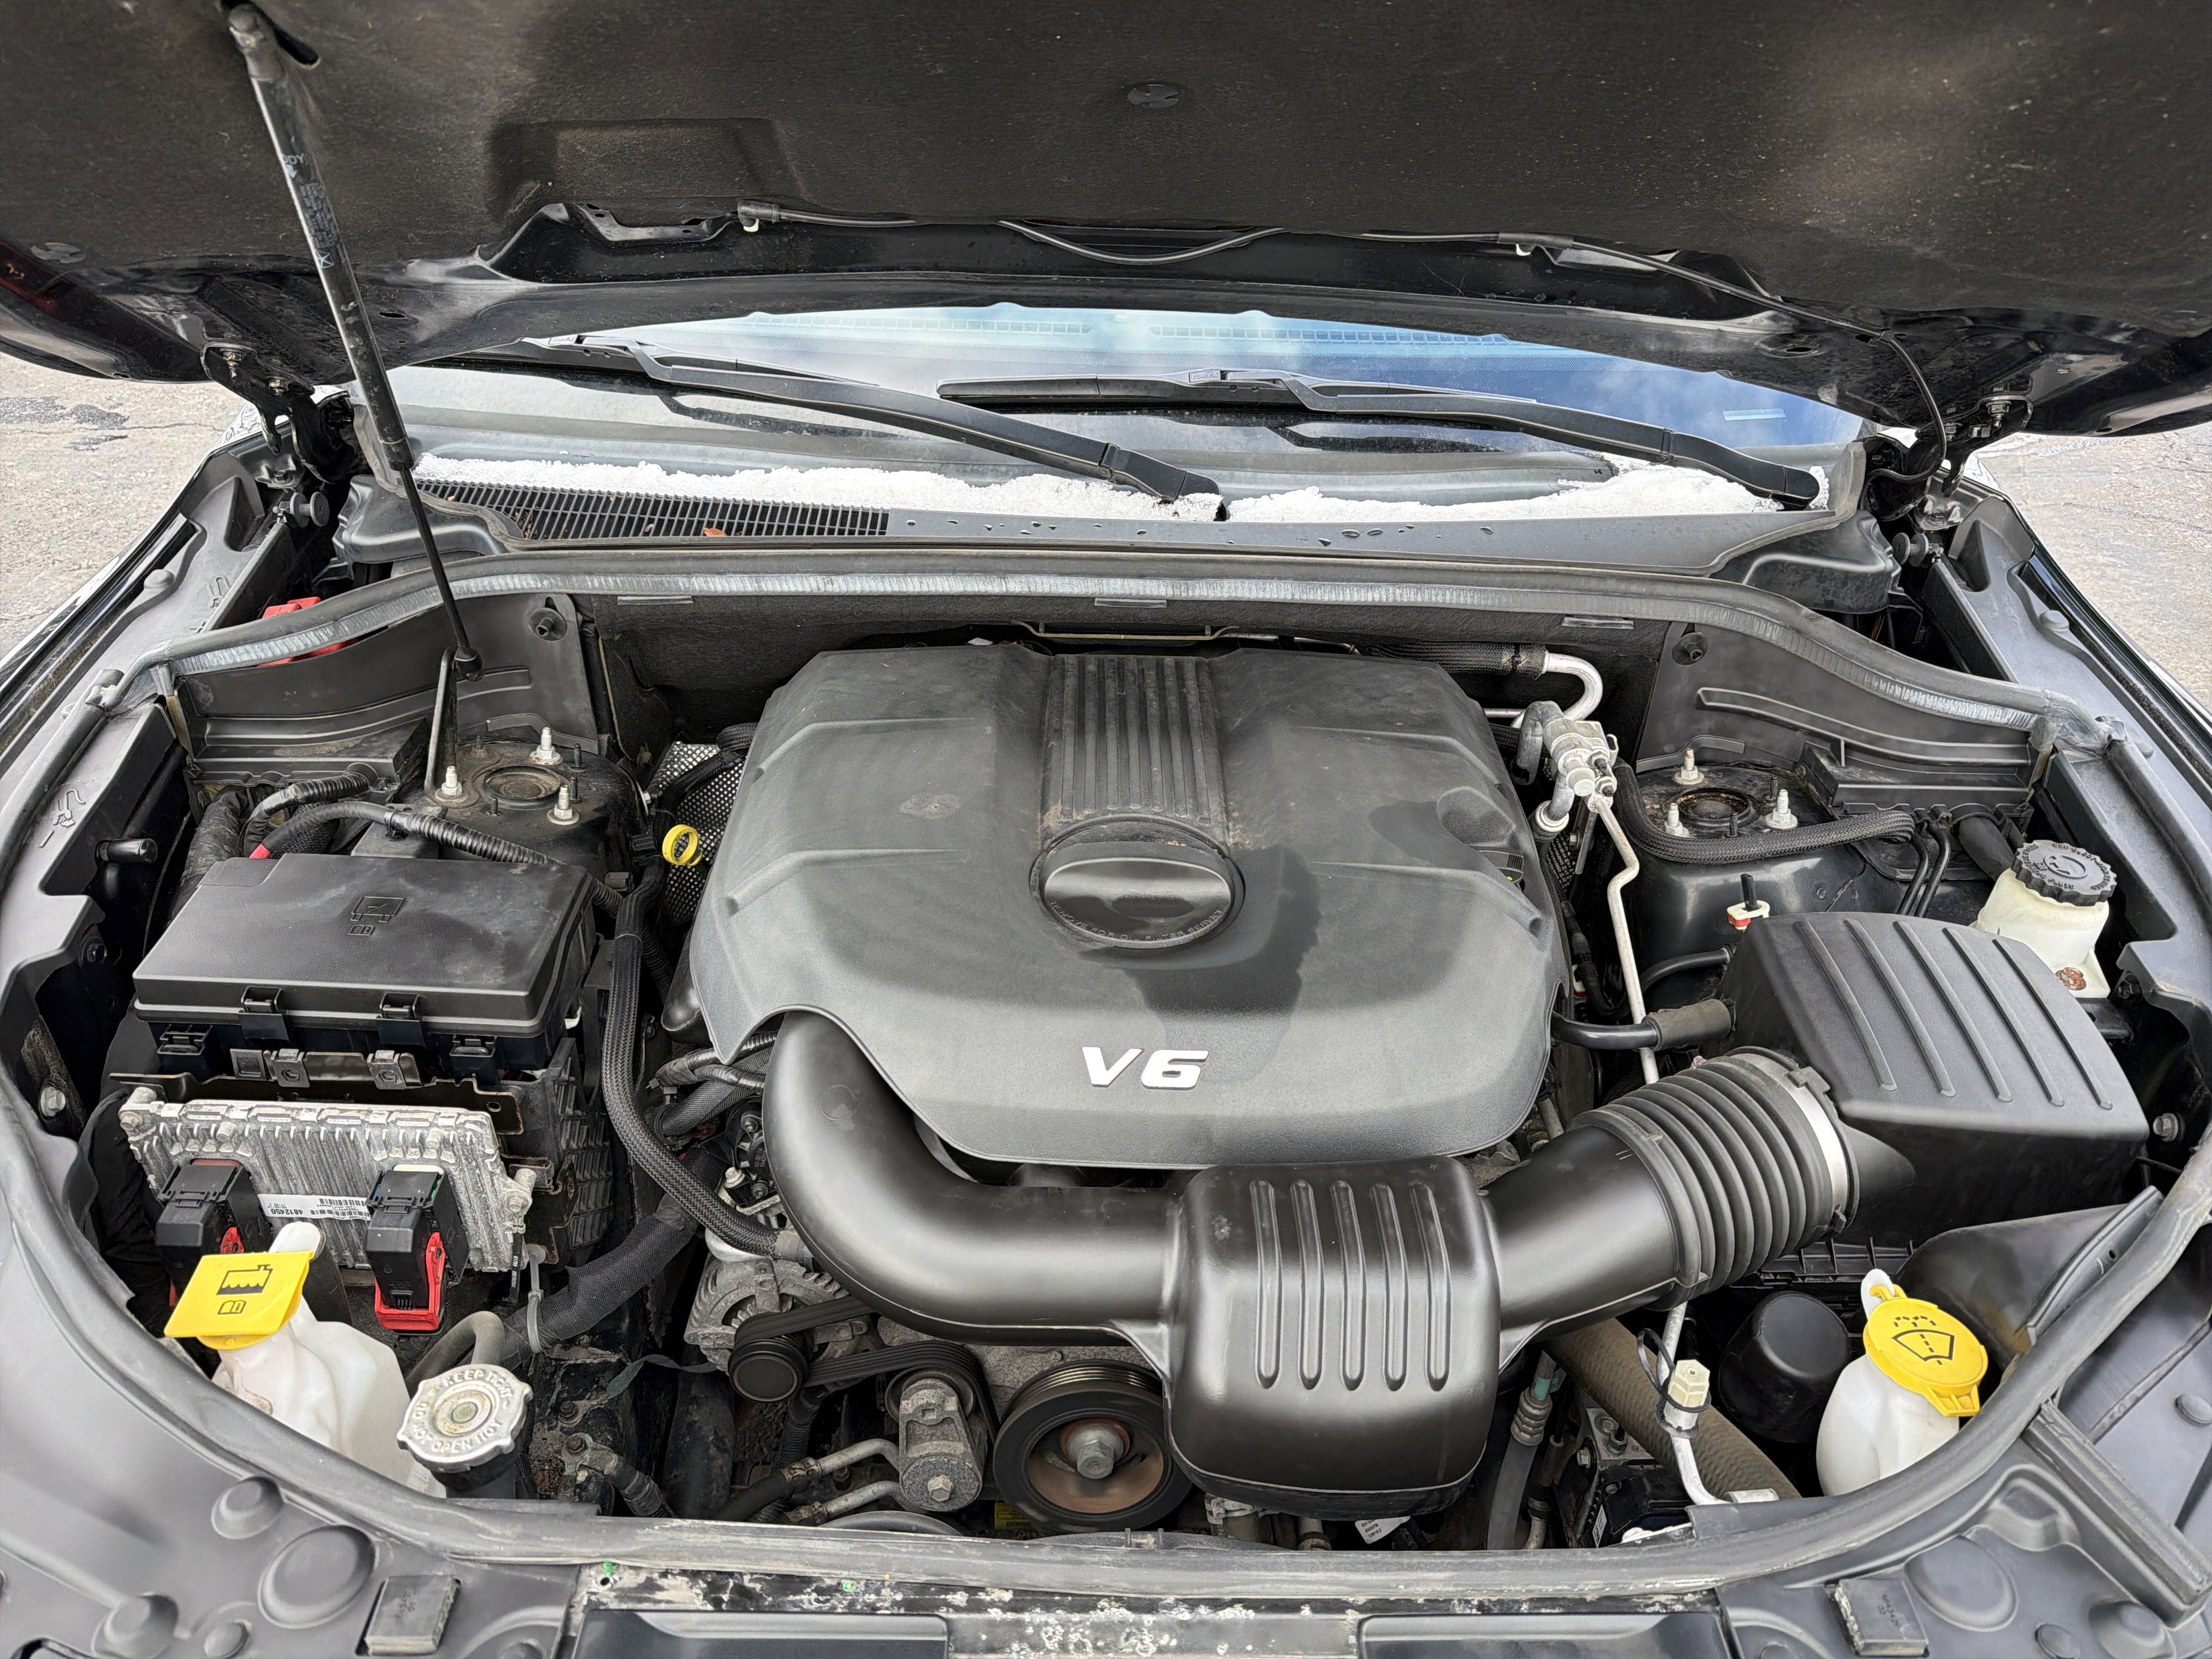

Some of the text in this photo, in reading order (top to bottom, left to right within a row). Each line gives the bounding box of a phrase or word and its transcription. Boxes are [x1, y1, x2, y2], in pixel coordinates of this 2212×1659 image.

[1090, 927, 1115, 939] FOR
[1187, 907, 1223, 933] SERVICE
[1082, 1046, 1210, 1091] V6
[442, 1369, 484, 1387] KEEP
[431, 1439, 472, 1454] OPEN
[475, 1423, 502, 1444] HOT
